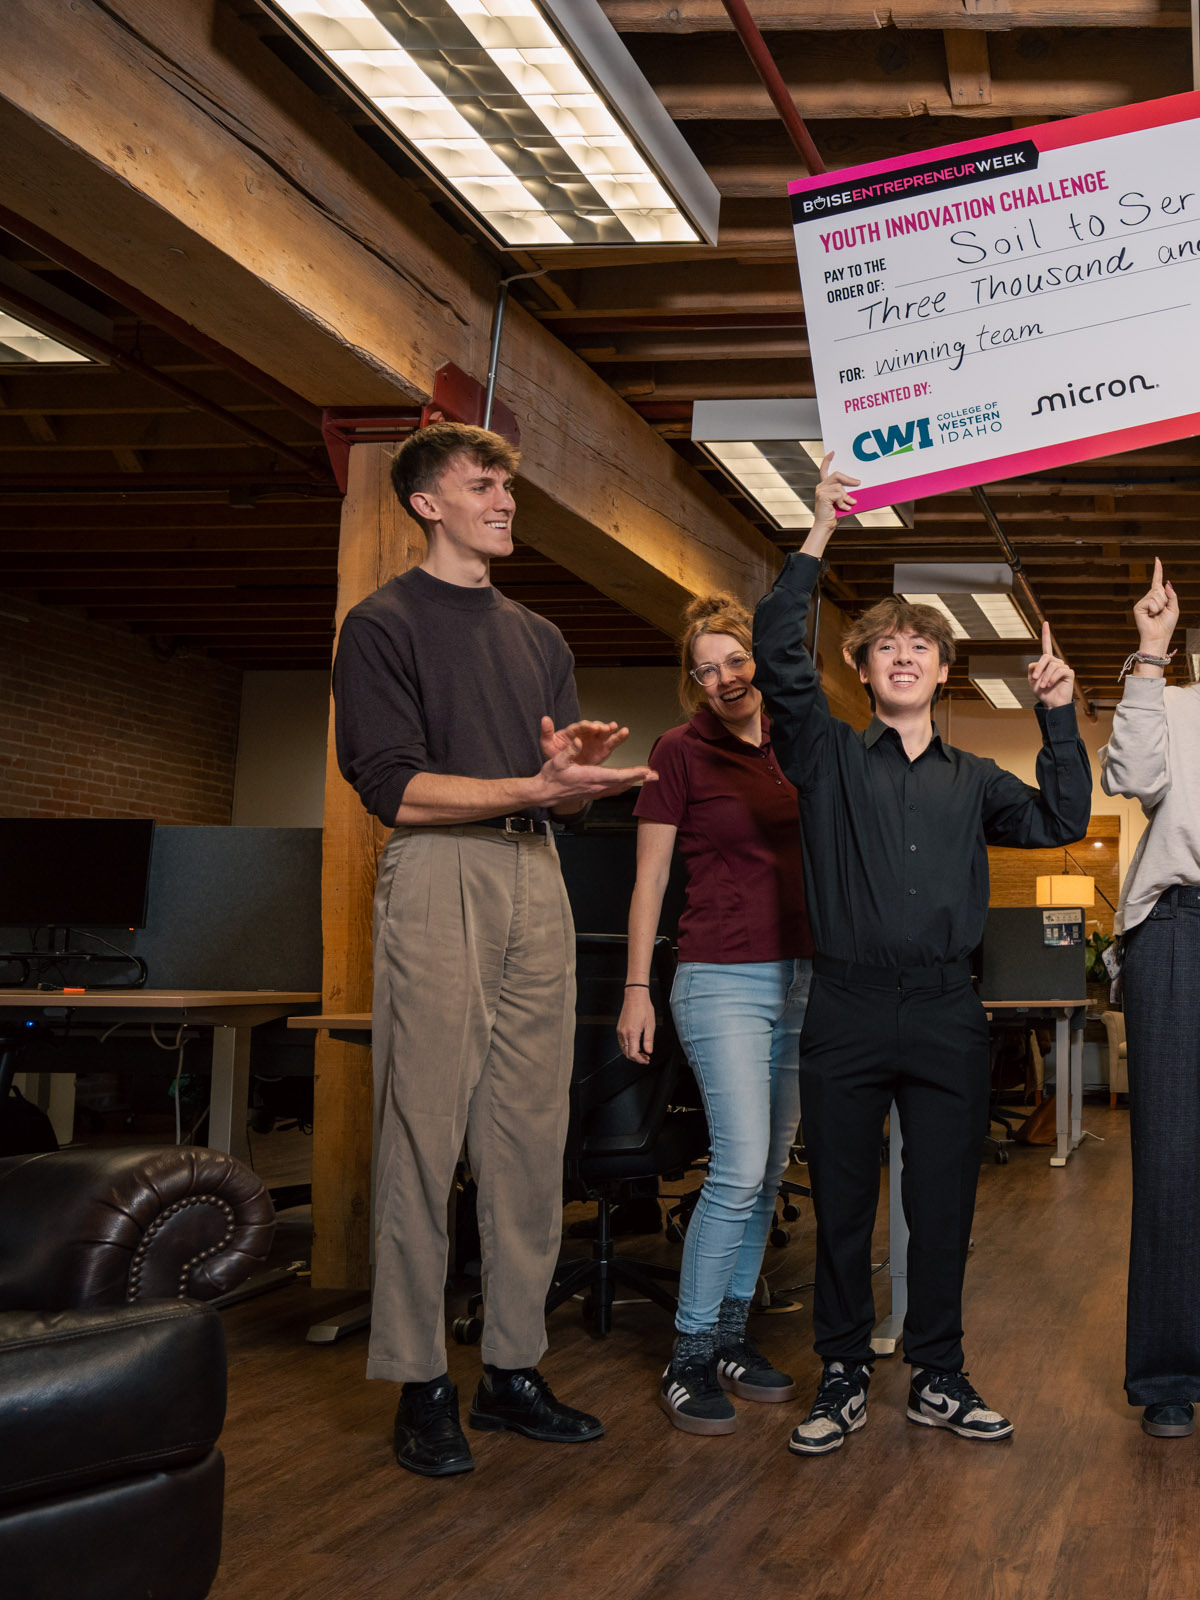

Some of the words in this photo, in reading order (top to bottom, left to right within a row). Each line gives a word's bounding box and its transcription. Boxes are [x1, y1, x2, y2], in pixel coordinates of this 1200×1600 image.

[819, 221, 881, 254] YOUTH
[885, 195, 996, 239] INNOVATION
[1000, 170, 1109, 212] CHALLENGE
[950, 218, 1041, 264] Soil
[1069, 213, 1105, 241] to
[824, 267, 845, 284] PAY
[847, 264, 862, 278] TO
[864, 258, 887, 275] THE
[827, 284, 864, 304] ORDER
[867, 279, 885, 294] OF:
[858, 291, 946, 329] Three
[970, 247, 1134, 304] Thousand
[976, 321, 1044, 351] team
[839, 367, 865, 384] FOR:
[844, 386, 911, 414] PRESENTED
[913, 381, 932, 397] BY:
[936, 405, 982, 422] COLLEGE
[984, 401, 998, 411] OF
[937, 410, 1001, 432] WESTERN
[940, 421, 1003, 445] IDAHO
[852, 417, 934, 462] CWI
